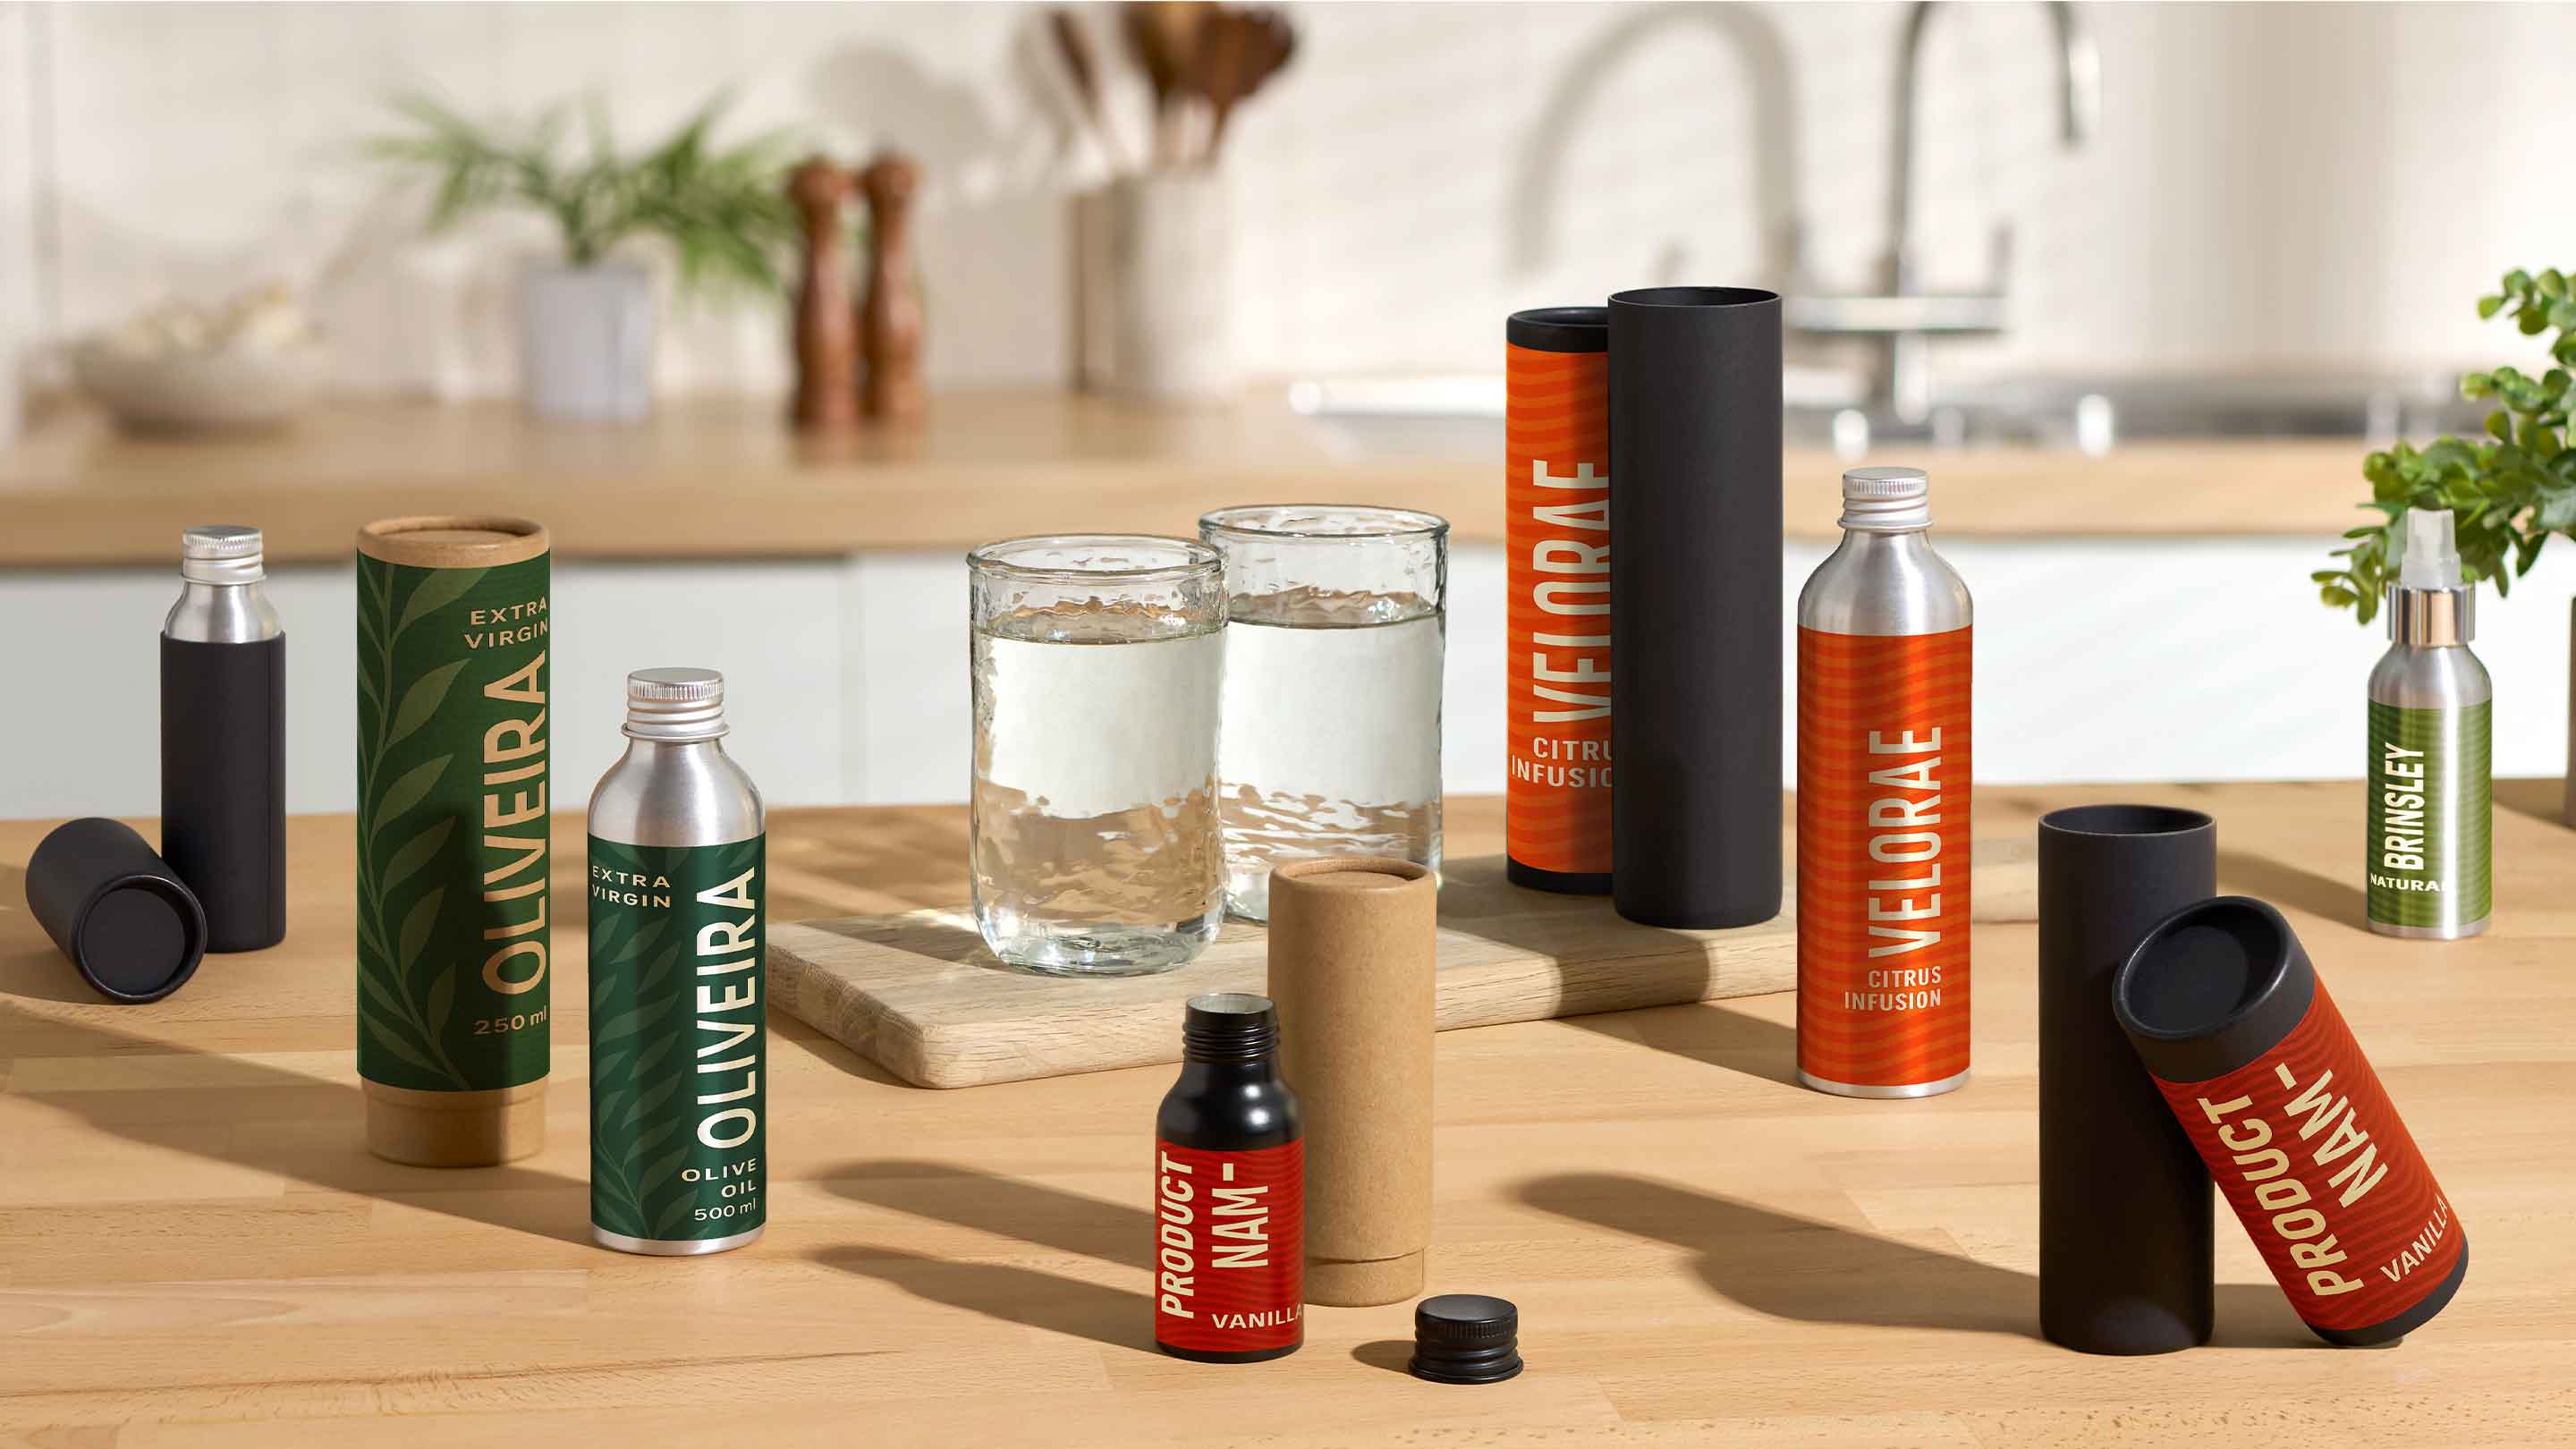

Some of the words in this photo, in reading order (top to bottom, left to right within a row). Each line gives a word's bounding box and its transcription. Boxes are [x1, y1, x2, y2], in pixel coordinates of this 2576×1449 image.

[470, 596, 547, 625] EXTRA
[463, 616, 548, 649] VIRGIN
[1512, 754, 1613, 788] INFUSIO
[481, 649, 546, 995] OLIVEIRA
[2384, 741, 2425, 870] BRINSLEY
[1868, 726, 1942, 958] VELORAE
[592, 865, 670, 888] EXTRA
[591, 884, 671, 908] VIRGIN
[1868, 965, 1941, 988] CITRUS
[697, 866, 755, 1148] OLIVEIRA
[1844, 988, 1941, 1011] INFUSION
[472, 1014, 525, 1035] 250
[530, 1004, 547, 1027] ml
[2275, 1063, 2388, 1208] NAM-
[681, 1158, 757, 1182] OLIVE
[721, 1180, 757, 1198] OIL
[2197, 1095, 2364, 1296] PRODUCT
[694, 1205, 735, 1221] 500
[740, 1197, 756, 1215] ml
[1211, 1163, 1268, 1269] NAM-
[1161, 1150, 1194, 1319] PRODUCT
[2379, 1194, 2448, 1283] VANILLA
[1211, 1302, 1302, 1329] VANILLA
